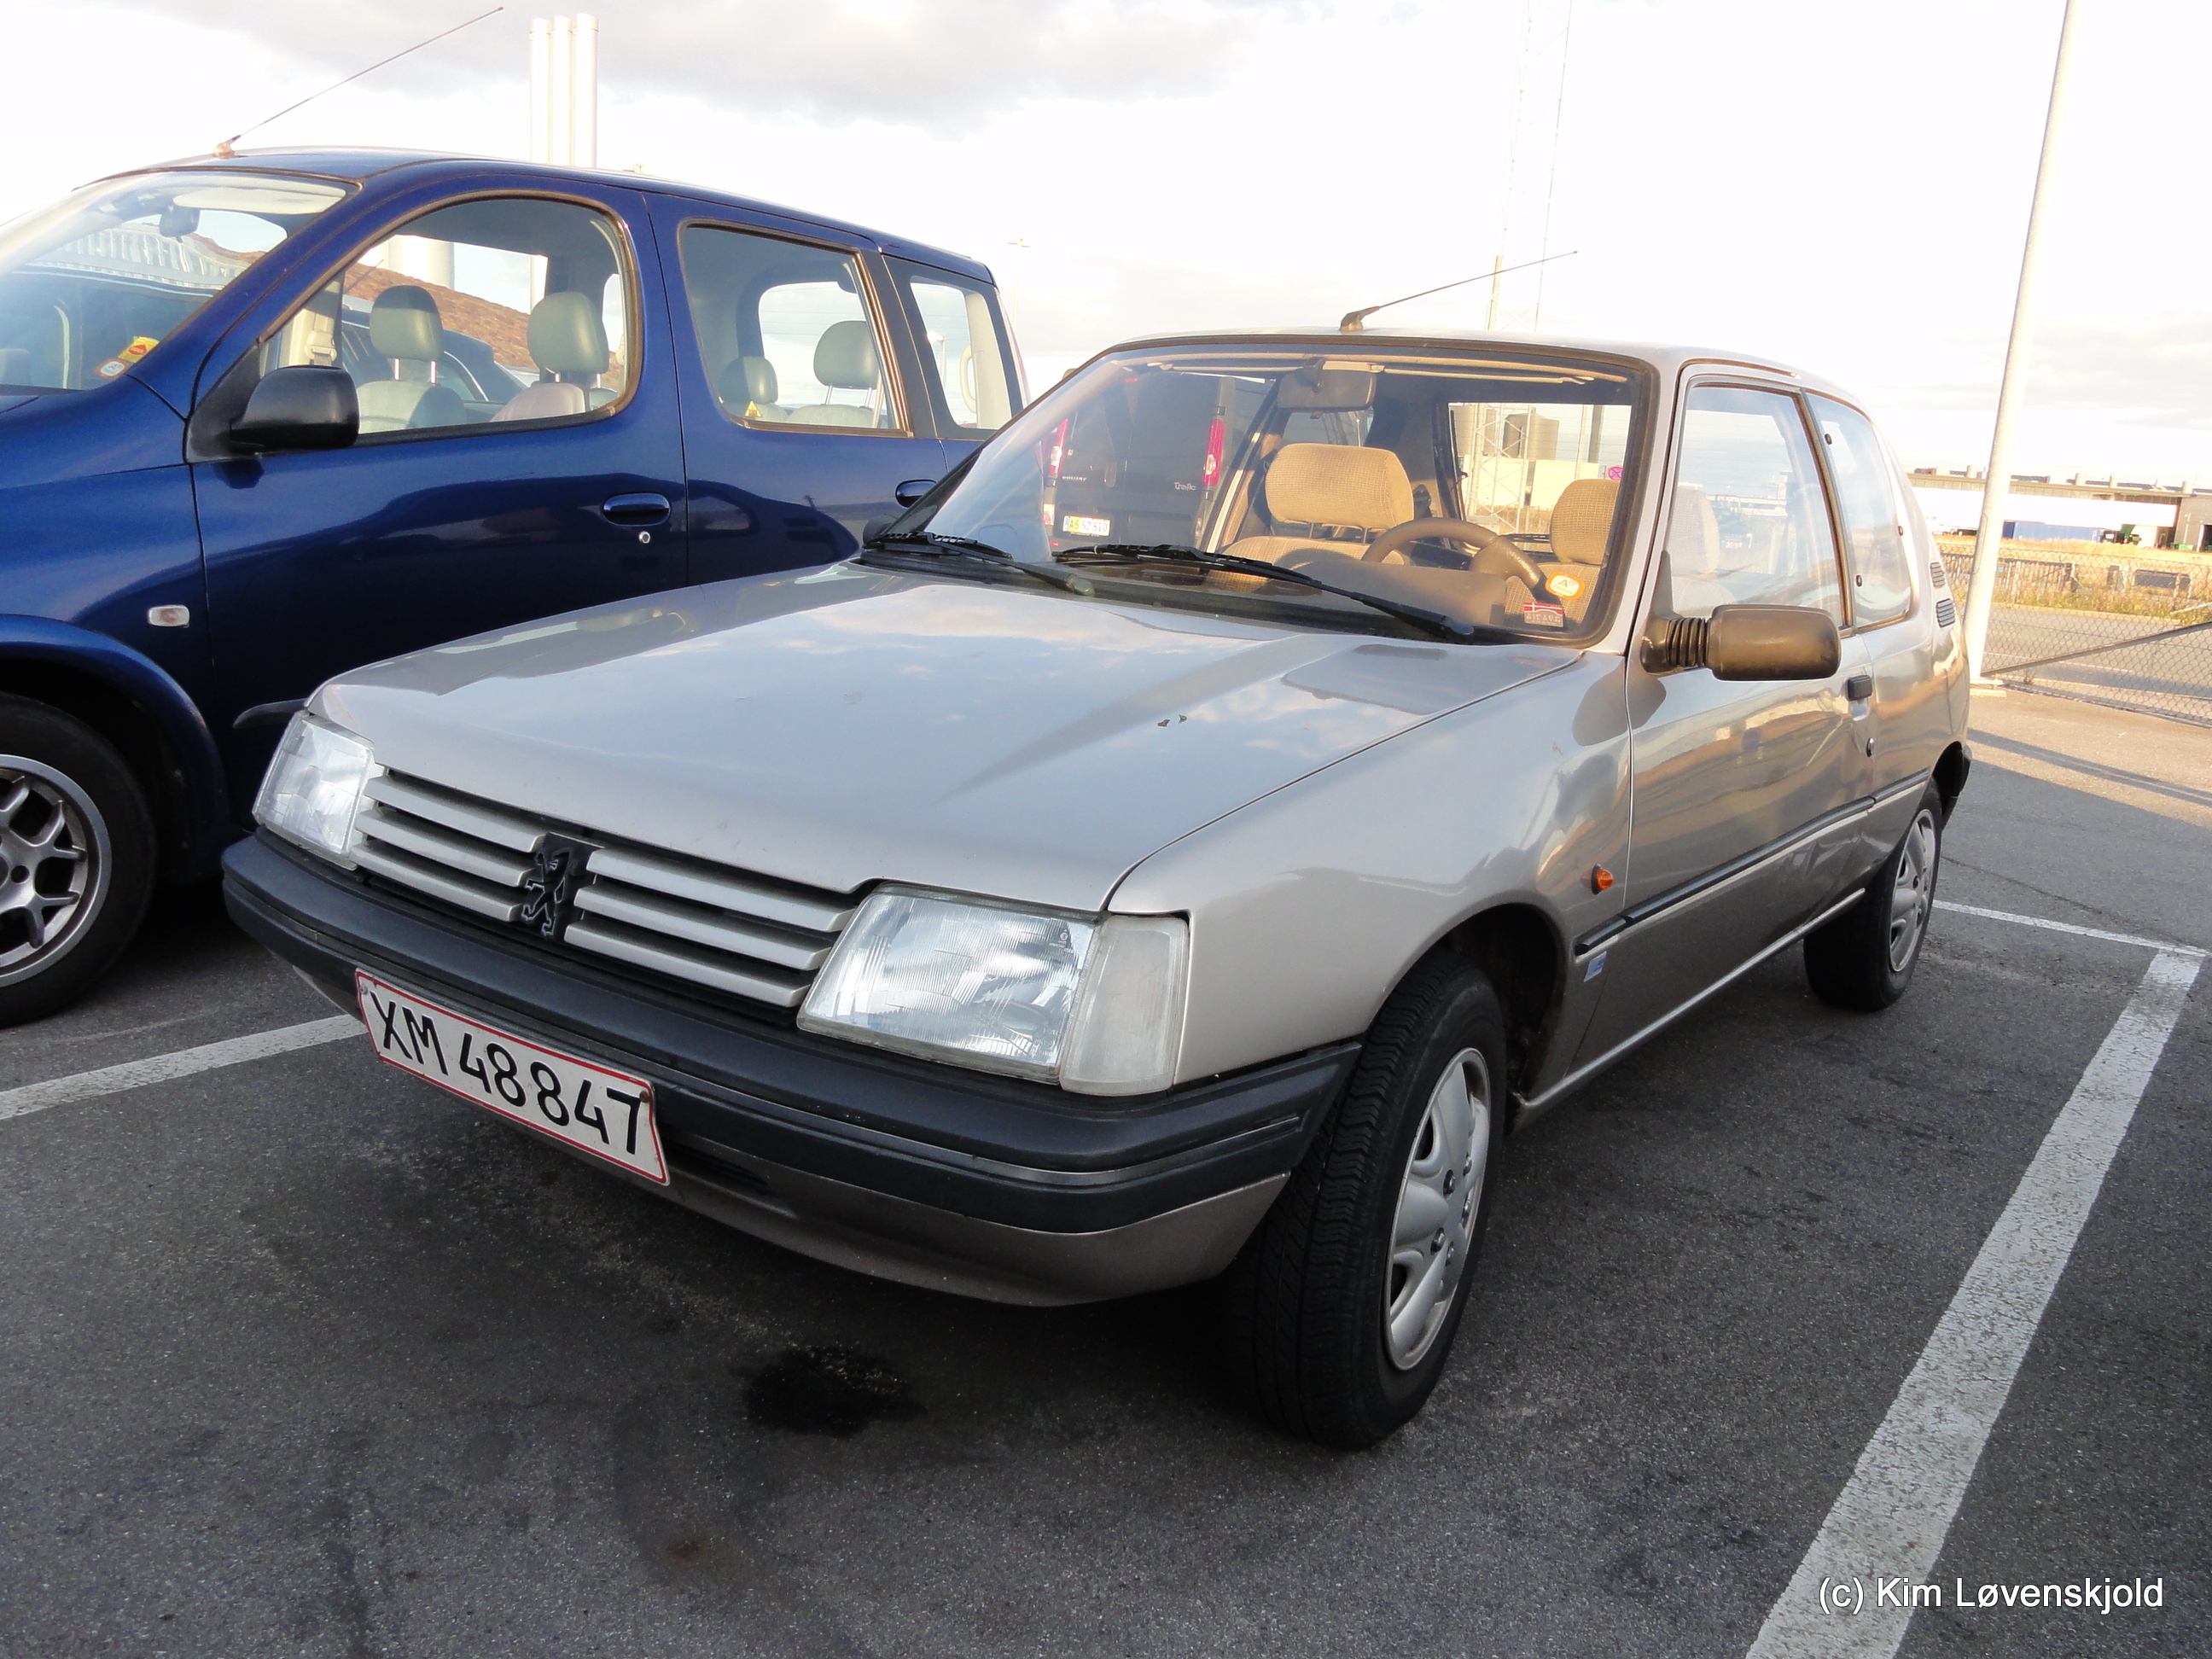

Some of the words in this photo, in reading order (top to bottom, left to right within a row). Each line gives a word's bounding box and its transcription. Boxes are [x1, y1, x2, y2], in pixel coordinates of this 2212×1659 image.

[1174, 481, 1196, 491] Trafic
[1069, 520, 1080, 530] AS
[370, 991, 449, 1076] XM
